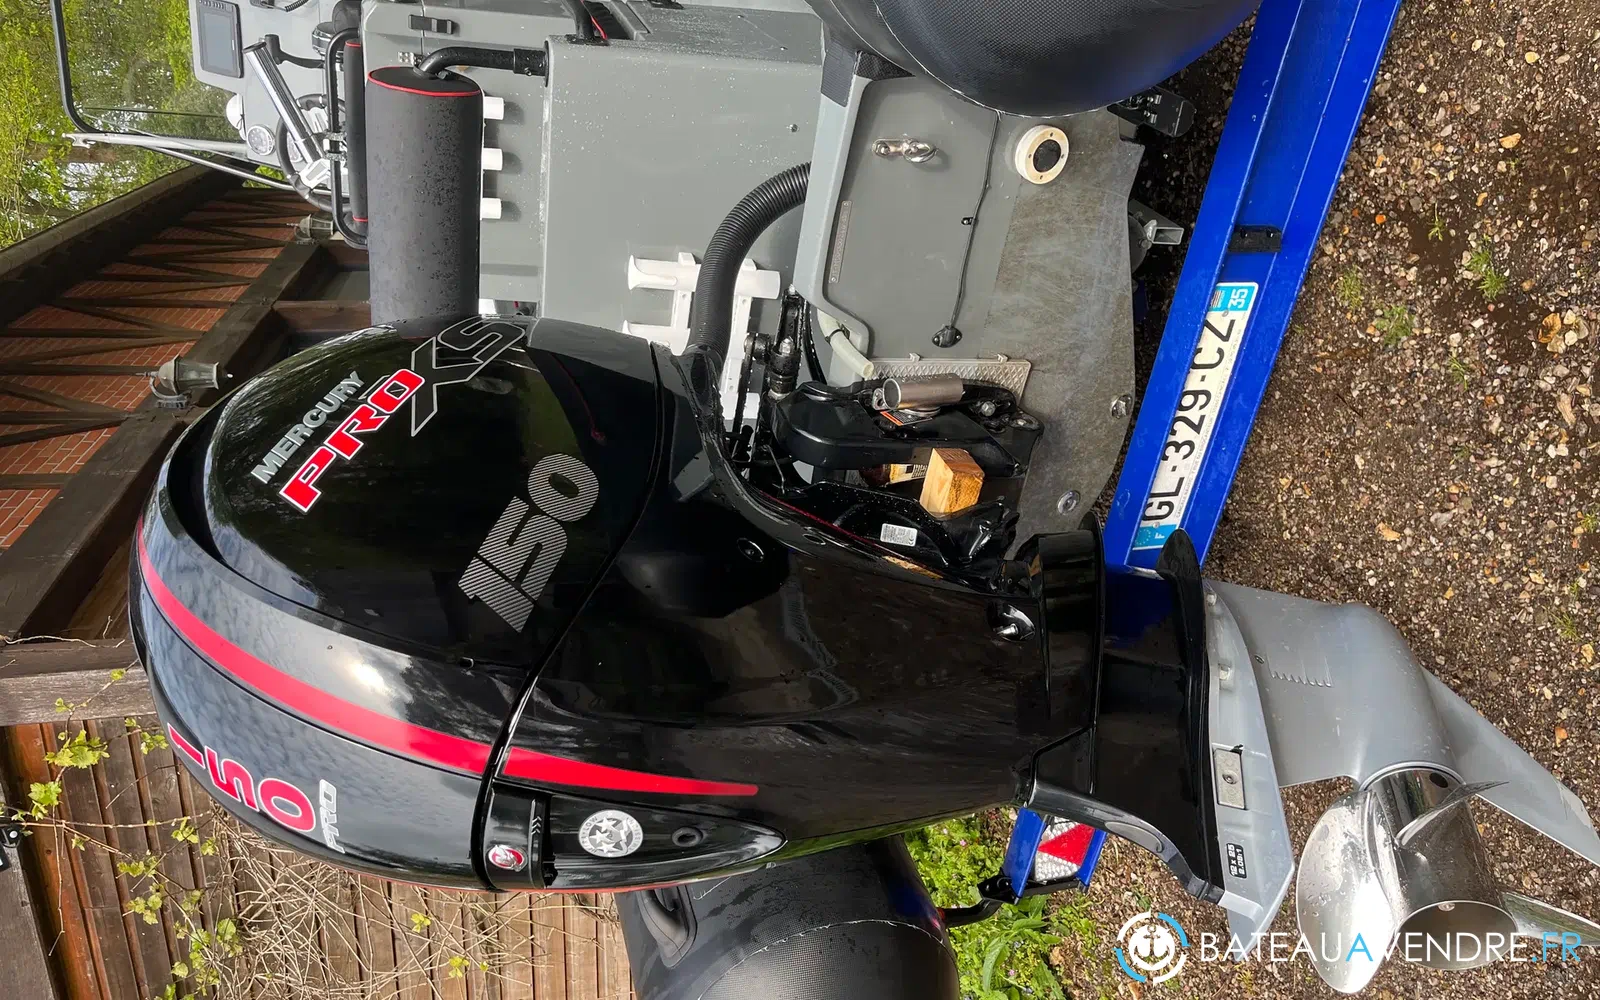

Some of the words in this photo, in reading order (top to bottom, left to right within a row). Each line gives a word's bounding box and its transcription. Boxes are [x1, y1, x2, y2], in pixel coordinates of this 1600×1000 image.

[1228, 288, 1249, 309] 35
[251, 371, 365, 484] MERCURY
[278, 368, 426, 513] PRO
[410, 315, 526, 437] XS
[457, 453, 600, 633] 150
[167, 722, 317, 832] 150
[319, 779, 345, 854] PRO
